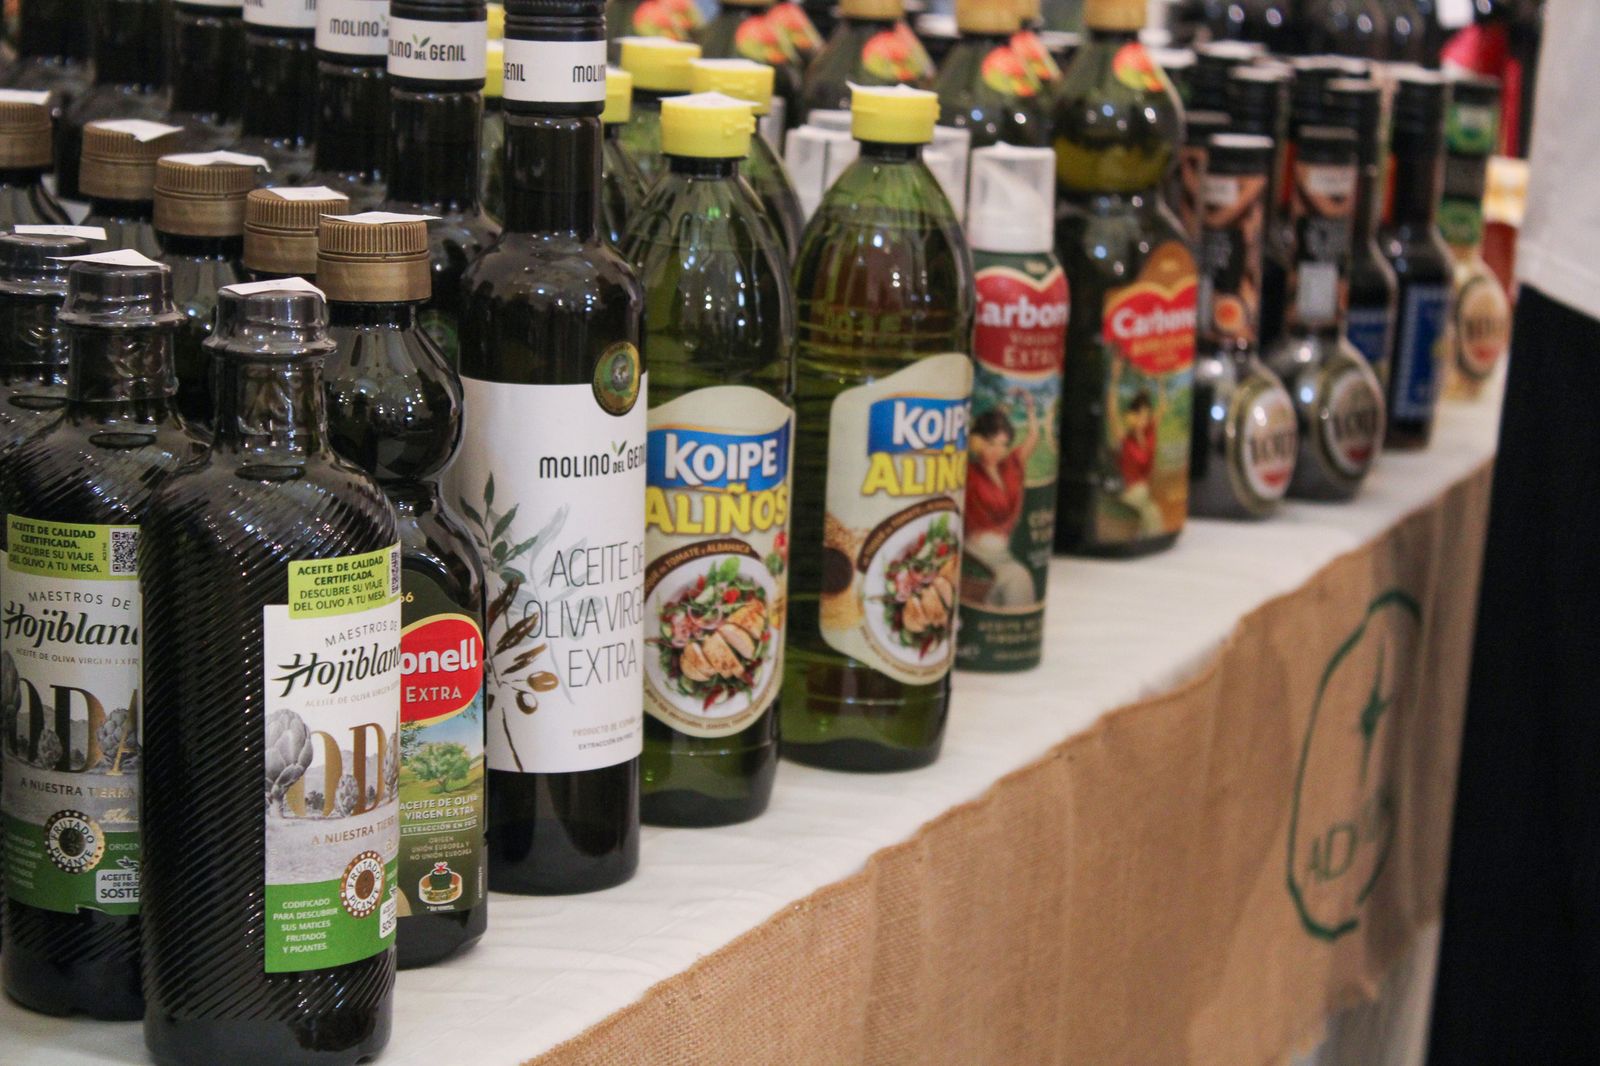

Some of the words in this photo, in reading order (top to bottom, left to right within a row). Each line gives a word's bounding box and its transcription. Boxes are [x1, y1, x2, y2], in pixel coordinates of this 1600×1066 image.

[330, 18, 379, 37] MOLINO
[414, 50, 427, 60] DEL
[430, 44, 466, 61] GENIL
[539, 452, 610, 479] MOLINO
[612, 460, 625, 474] DEL
[664, 433, 778, 486] KOIPE
[645, 481, 788, 535] ALIÑOS
[12, 521, 35, 533] ACEITE
[38, 526, 49, 536] DE
[52, 528, 96, 539] CALIDAD
[21, 534, 81, 549] CERTIFICADA.
[12, 543, 50, 558] DESCUBRE
[53, 550, 65, 560] SU
[67, 551, 94, 561] VIAJE
[22, 556, 46, 569] OLIVO
[47, 561, 54, 570] A
[56, 561, 68, 571] TU
[71, 563, 102, 573] MESA.
[297, 563, 333, 576] ACEITE
[336, 561, 349, 572] DE
[351, 555, 384, 570] CALIDAD
[548, 541, 628, 588] ACEITE
[300, 585, 350, 600] DESCUBRE
[352, 582, 362, 593] SU
[364, 579, 383, 592] VIAJE
[28, 590, 104, 605] MAESTROS
[112, 597, 132, 610] DE
[293, 601, 313, 612] DEL
[316, 598, 345, 610] OLIVO
[347, 597, 354, 606] A
[356, 594, 366, 604] TU
[523, 597, 600, 639] OLIVA
[325, 620, 387, 647] MAESTROS
[16, 647, 36, 658] ACEITE
[51, 654, 76, 664] OLIVA
[399, 636, 479, 676] onell
[568, 638, 638, 688] EXTRA
[405, 685, 462, 703] EXTRA
[29, 780, 83, 797] NUESTRA
[400, 799, 436, 811] ACEITE
[438, 797, 453, 807] DE
[405, 809, 443, 821] VIRGEN
[446, 806, 475, 817] EXTRA
[50, 819, 95, 844] FRUTADO
[324, 825, 374, 844] NUESTRA
[435, 841, 464, 851] EUROPEA
[51, 846, 95, 868] PICANTE
[101, 872, 133, 882] ACEITE
[348, 861, 381, 889] FRUTADO
[282, 898, 331, 910] CODIFICADO
[273, 912, 294, 921] PARA
[281, 924, 297, 932] SUS
[299, 920, 331, 931] MATICES
[285, 931, 327, 943] FRUTADOS
[282, 945, 288, 954] Y
[290, 942, 328, 953] PICANTES
